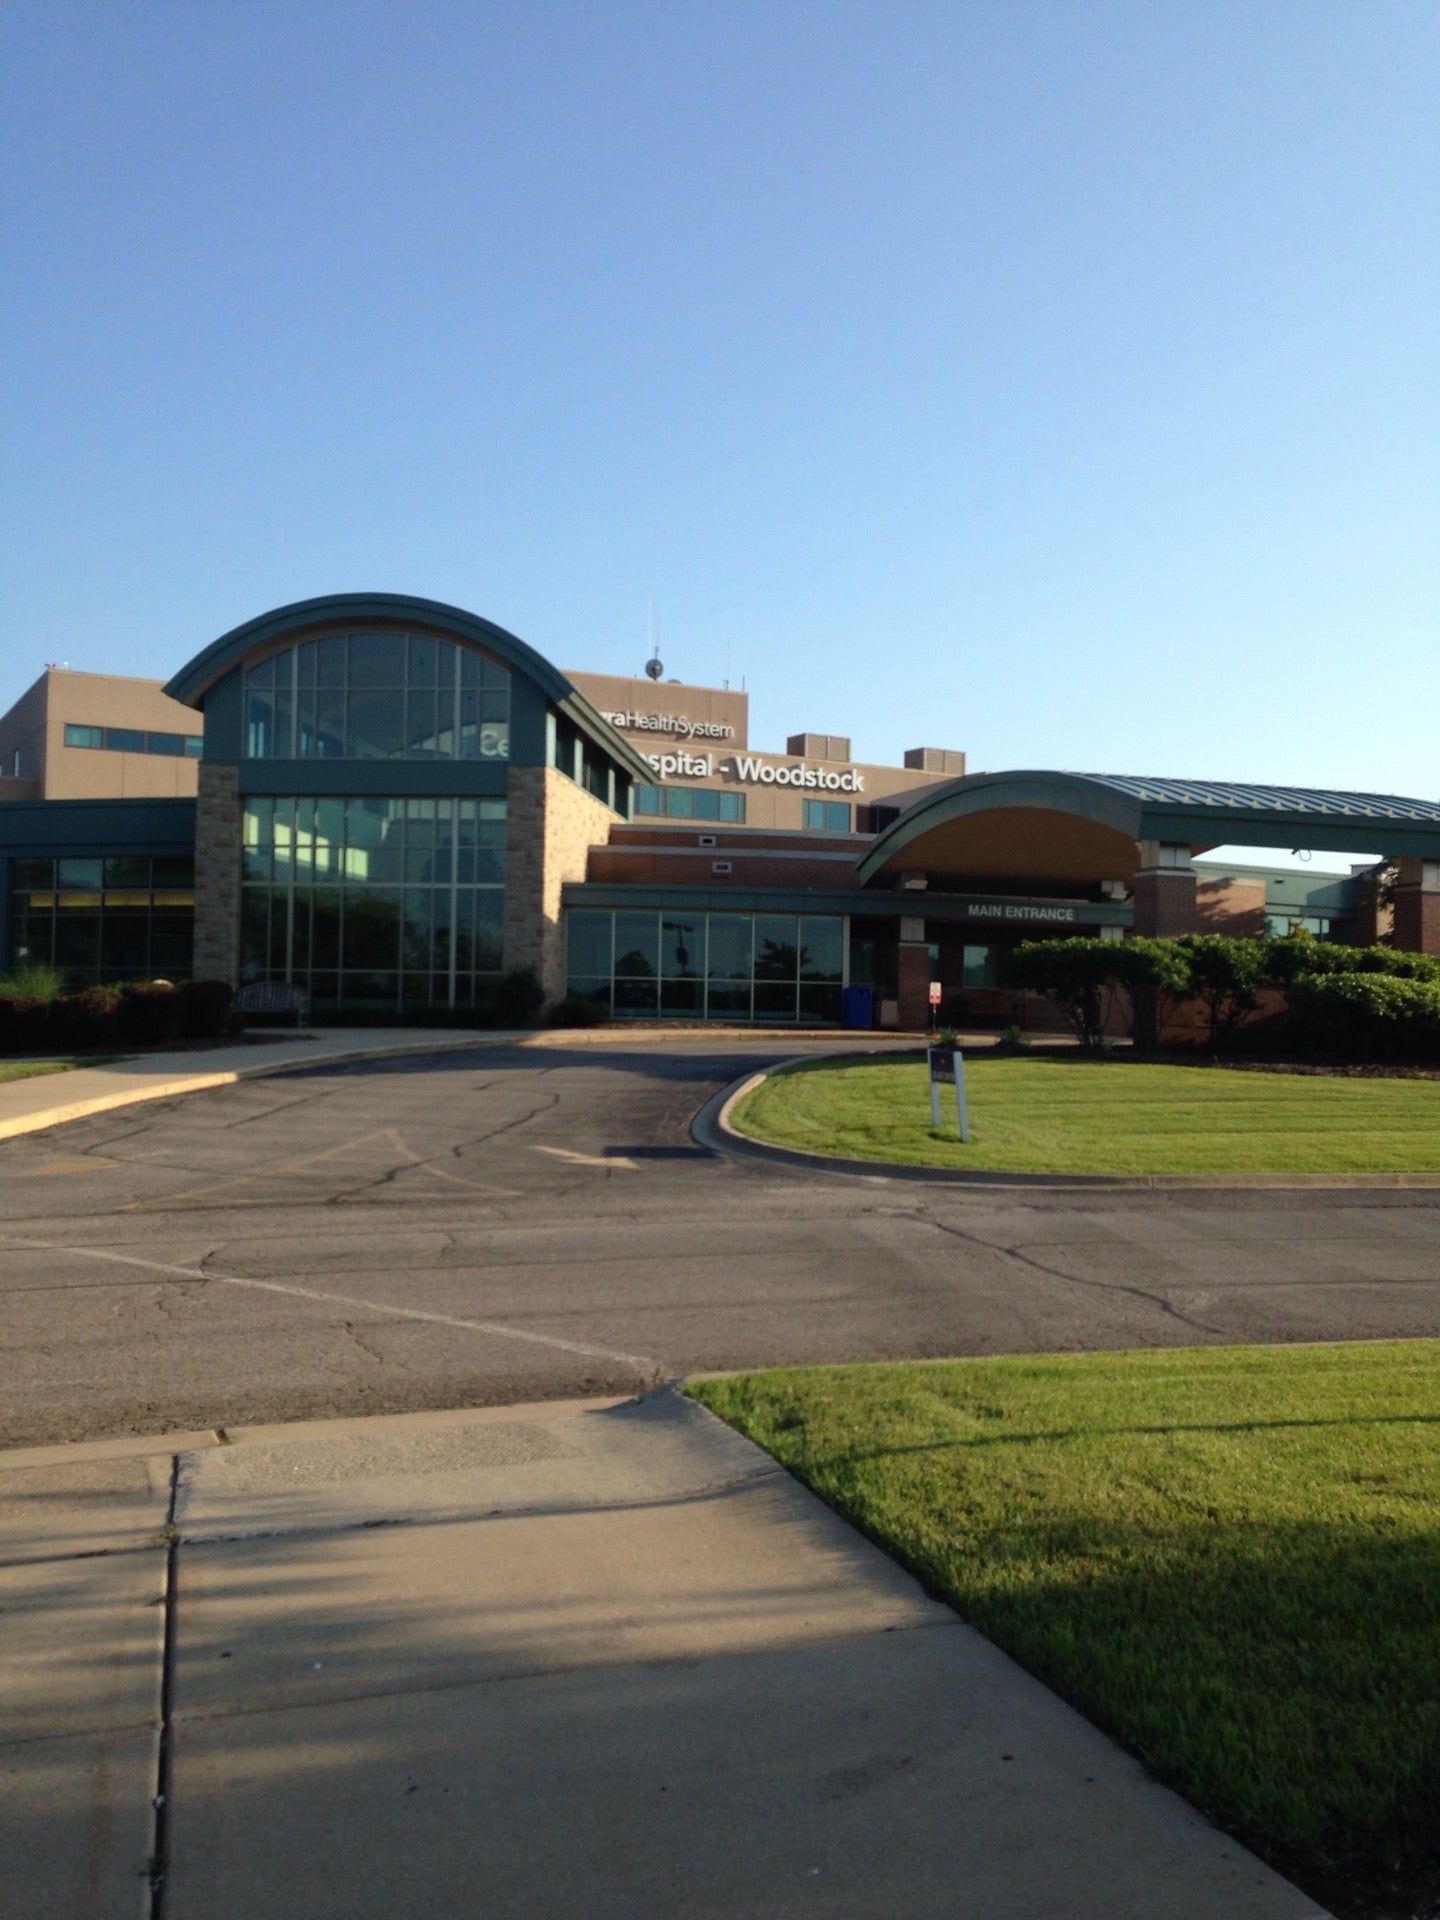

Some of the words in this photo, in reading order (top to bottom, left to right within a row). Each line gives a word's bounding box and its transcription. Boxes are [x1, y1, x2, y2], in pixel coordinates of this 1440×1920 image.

[600, 710, 735, 738] raHealthSystem
[735, 756, 864, 792] Woodstock
[968, 904, 1002, 917] MAIN
[1005, 905, 1075, 921] ENTRANCE
